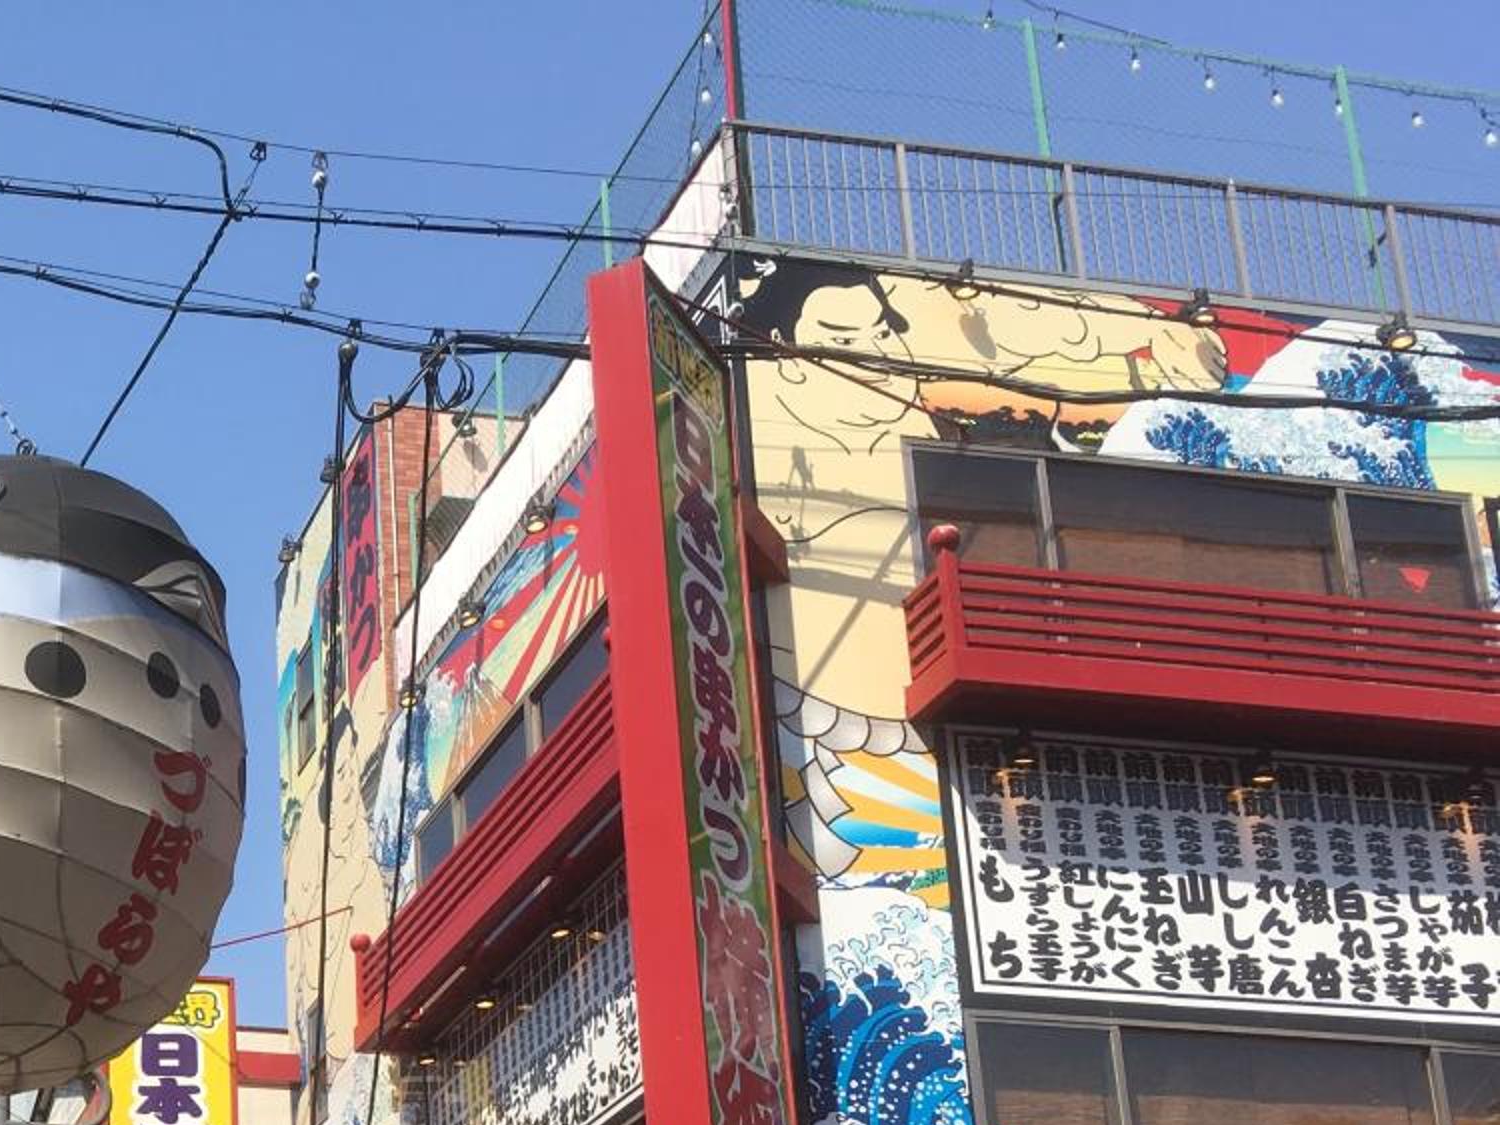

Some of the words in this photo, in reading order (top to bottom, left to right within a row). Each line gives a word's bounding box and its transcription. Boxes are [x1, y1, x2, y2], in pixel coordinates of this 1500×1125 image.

[979, 854, 1023, 979] もち
[1019, 856, 1067, 981] うずら玉子
[1057, 860, 1107, 984] 紅しょうが
[1098, 864, 1143, 988] にんにく
[1137, 867, 1186, 991] 玉ねぎ
[1178, 869, 1224, 992] 山芋
[1218, 872, 1265, 995] しし唐
[1256, 874, 1306, 998] れんこん
[1293, 877, 1342, 999] 銀杏
[1334, 882, 1380, 1002] 白ねぎ
[1373, 884, 1420, 1006] さつま芋
[1409, 886, 1459, 1008] じゃが芋
[1446, 890, 1497, 1010] 茄子
